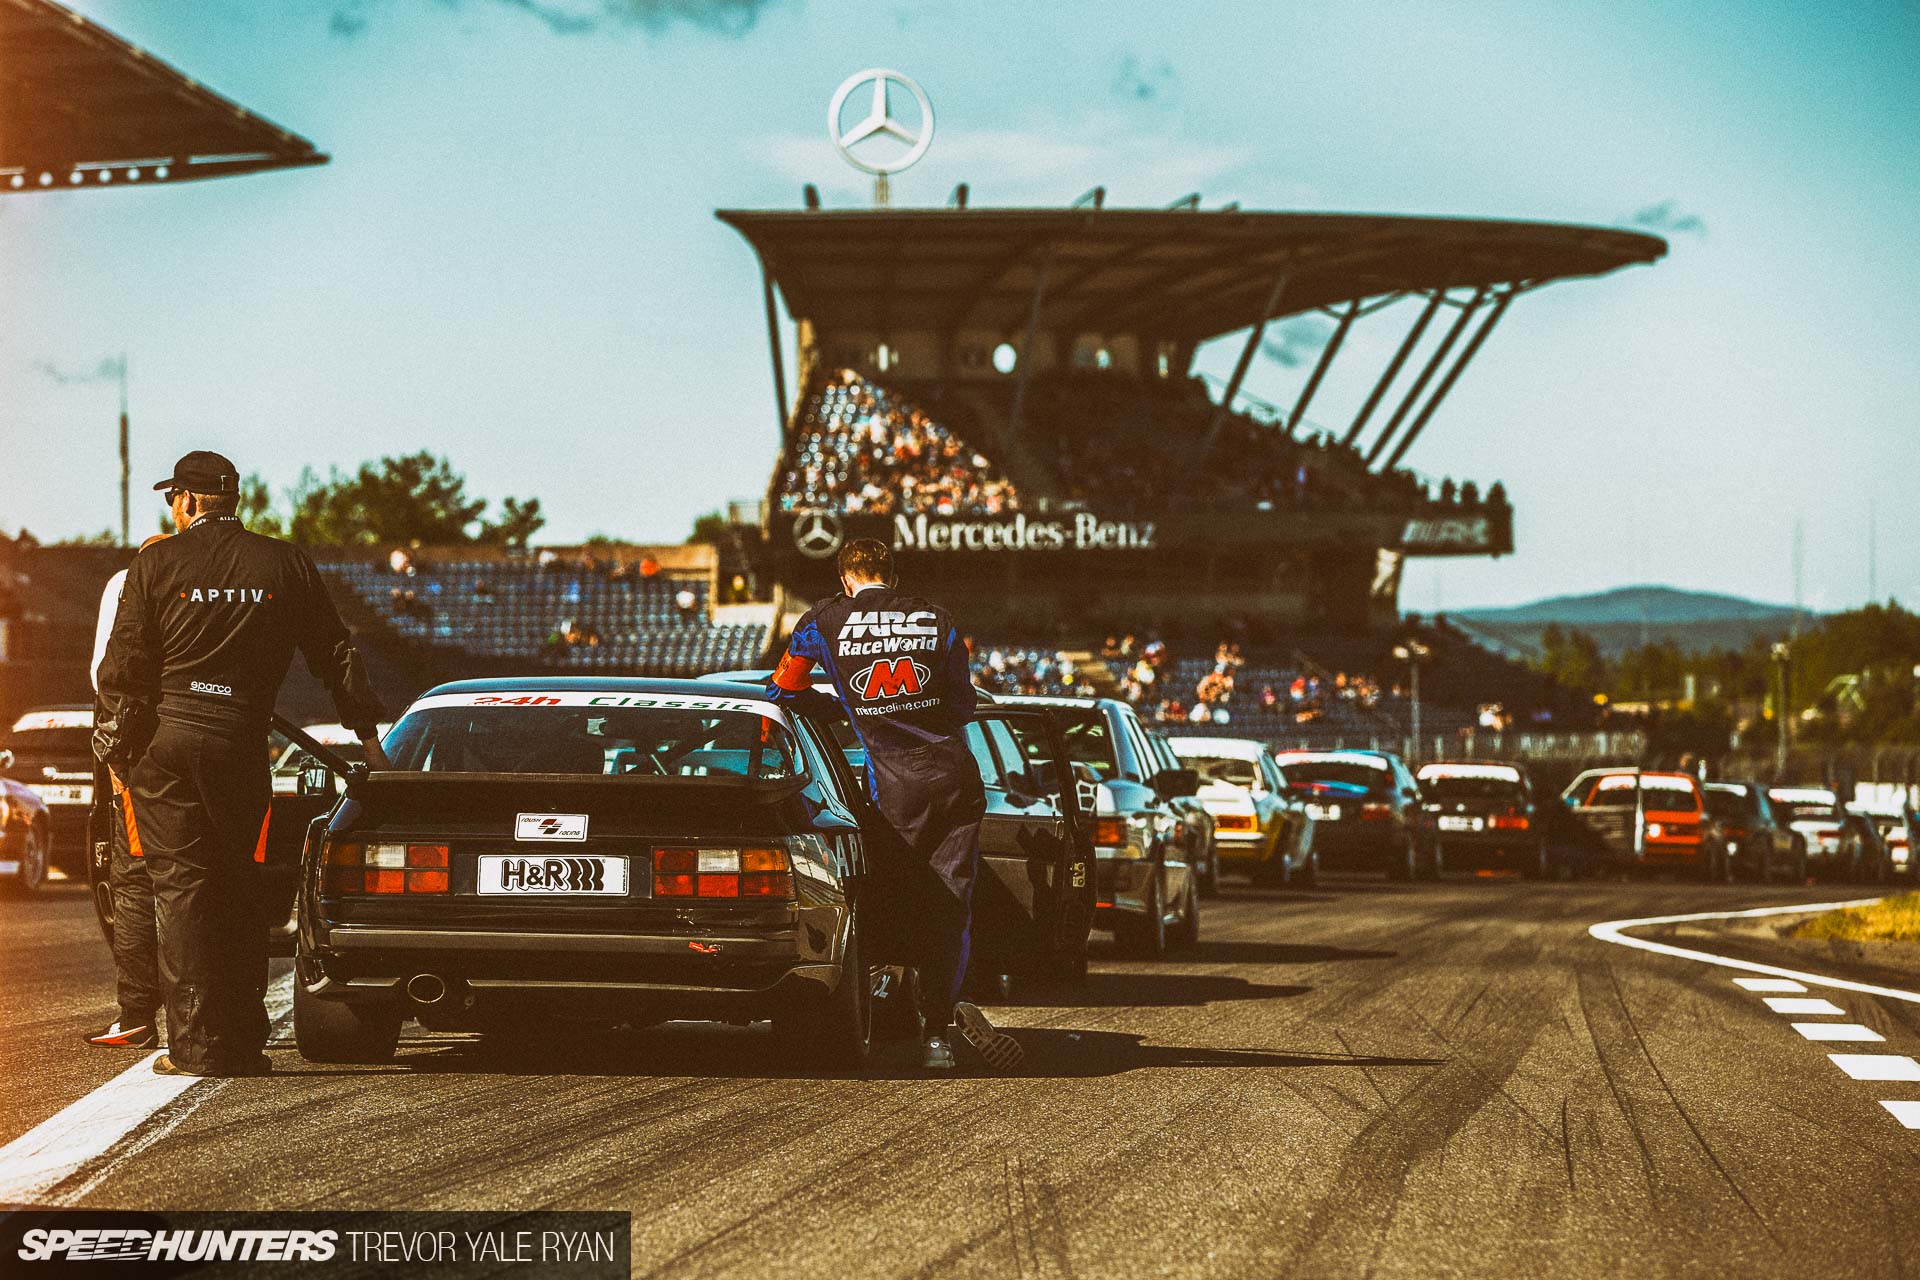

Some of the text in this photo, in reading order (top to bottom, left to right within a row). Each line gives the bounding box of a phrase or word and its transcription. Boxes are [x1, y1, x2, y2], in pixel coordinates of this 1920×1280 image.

[894, 513, 1156, 550] Mercedes-Benz
[190, 588, 264, 603] APTIV
[837, 611, 938, 640] MRC
[838, 636, 938, 657] RaceWorld
[190, 681, 232, 695] sparco
[474, 696, 753, 712] 24h Classic
[502, 859, 570, 891] H&R
